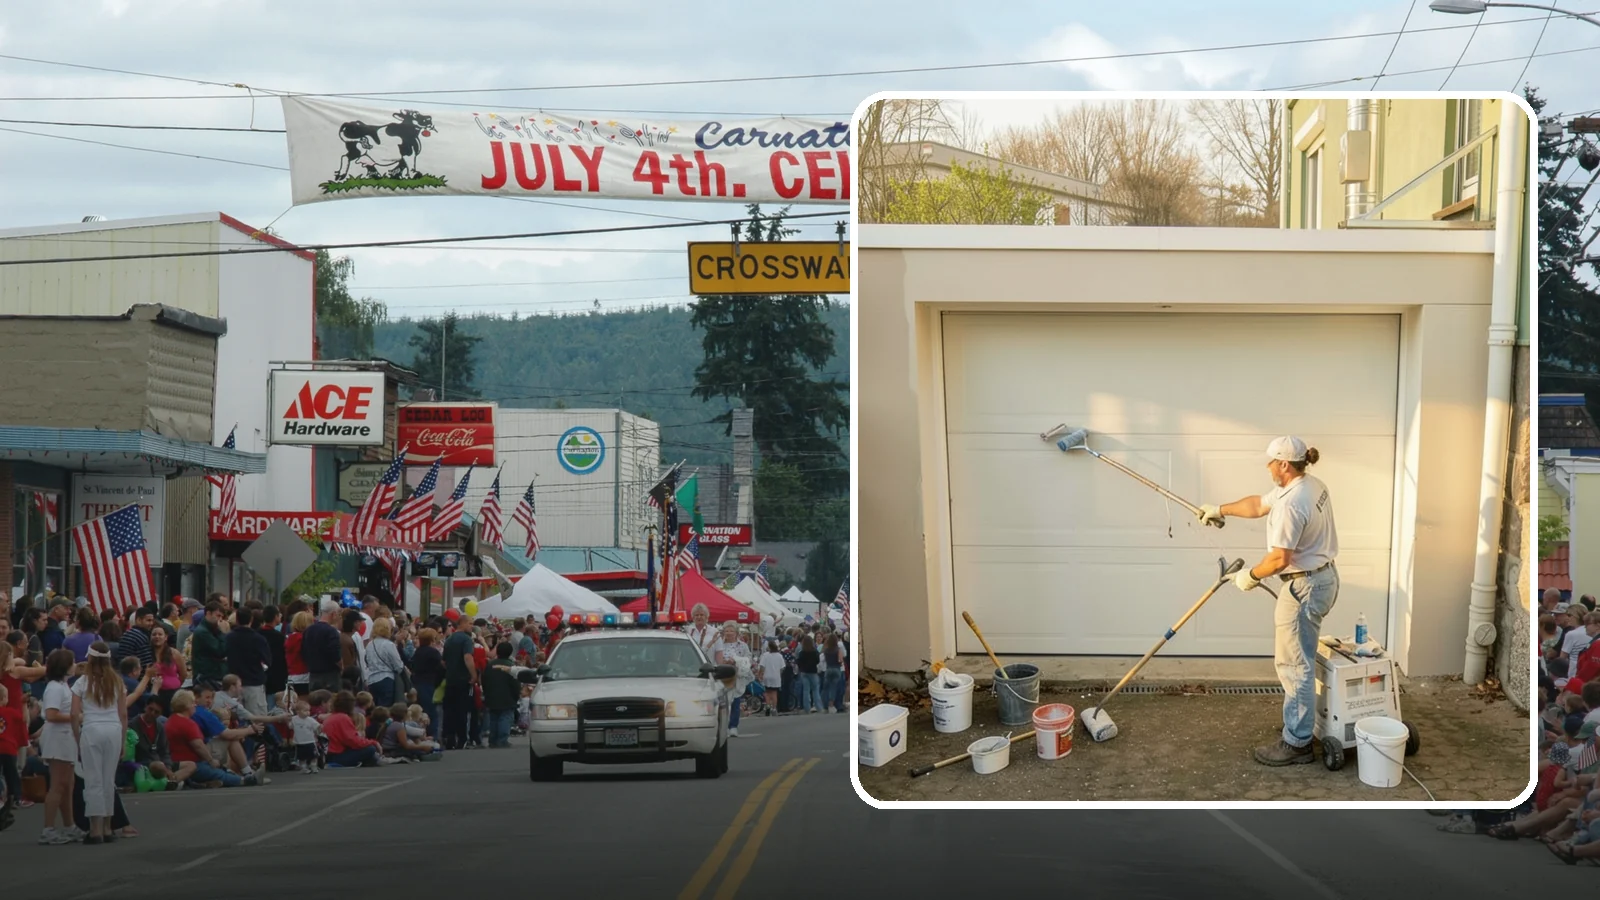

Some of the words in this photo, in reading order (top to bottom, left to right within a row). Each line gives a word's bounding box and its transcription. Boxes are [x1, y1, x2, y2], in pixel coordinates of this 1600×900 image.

[481, 141, 605, 193] JULY
[633, 150, 747, 198] 4th.
[697, 254, 850, 280] CROSSWA
[282, 380, 373, 420] ACE
[283, 421, 371, 436] Hardware
[416, 428, 477, 447] Coca-Cola
[95, 485, 124, 495] Vincent
[125, 486, 136, 495] de
[137, 486, 155, 495] Paul
[688, 526, 741, 535] CRNATION
[699, 535, 730, 543] GLASS
